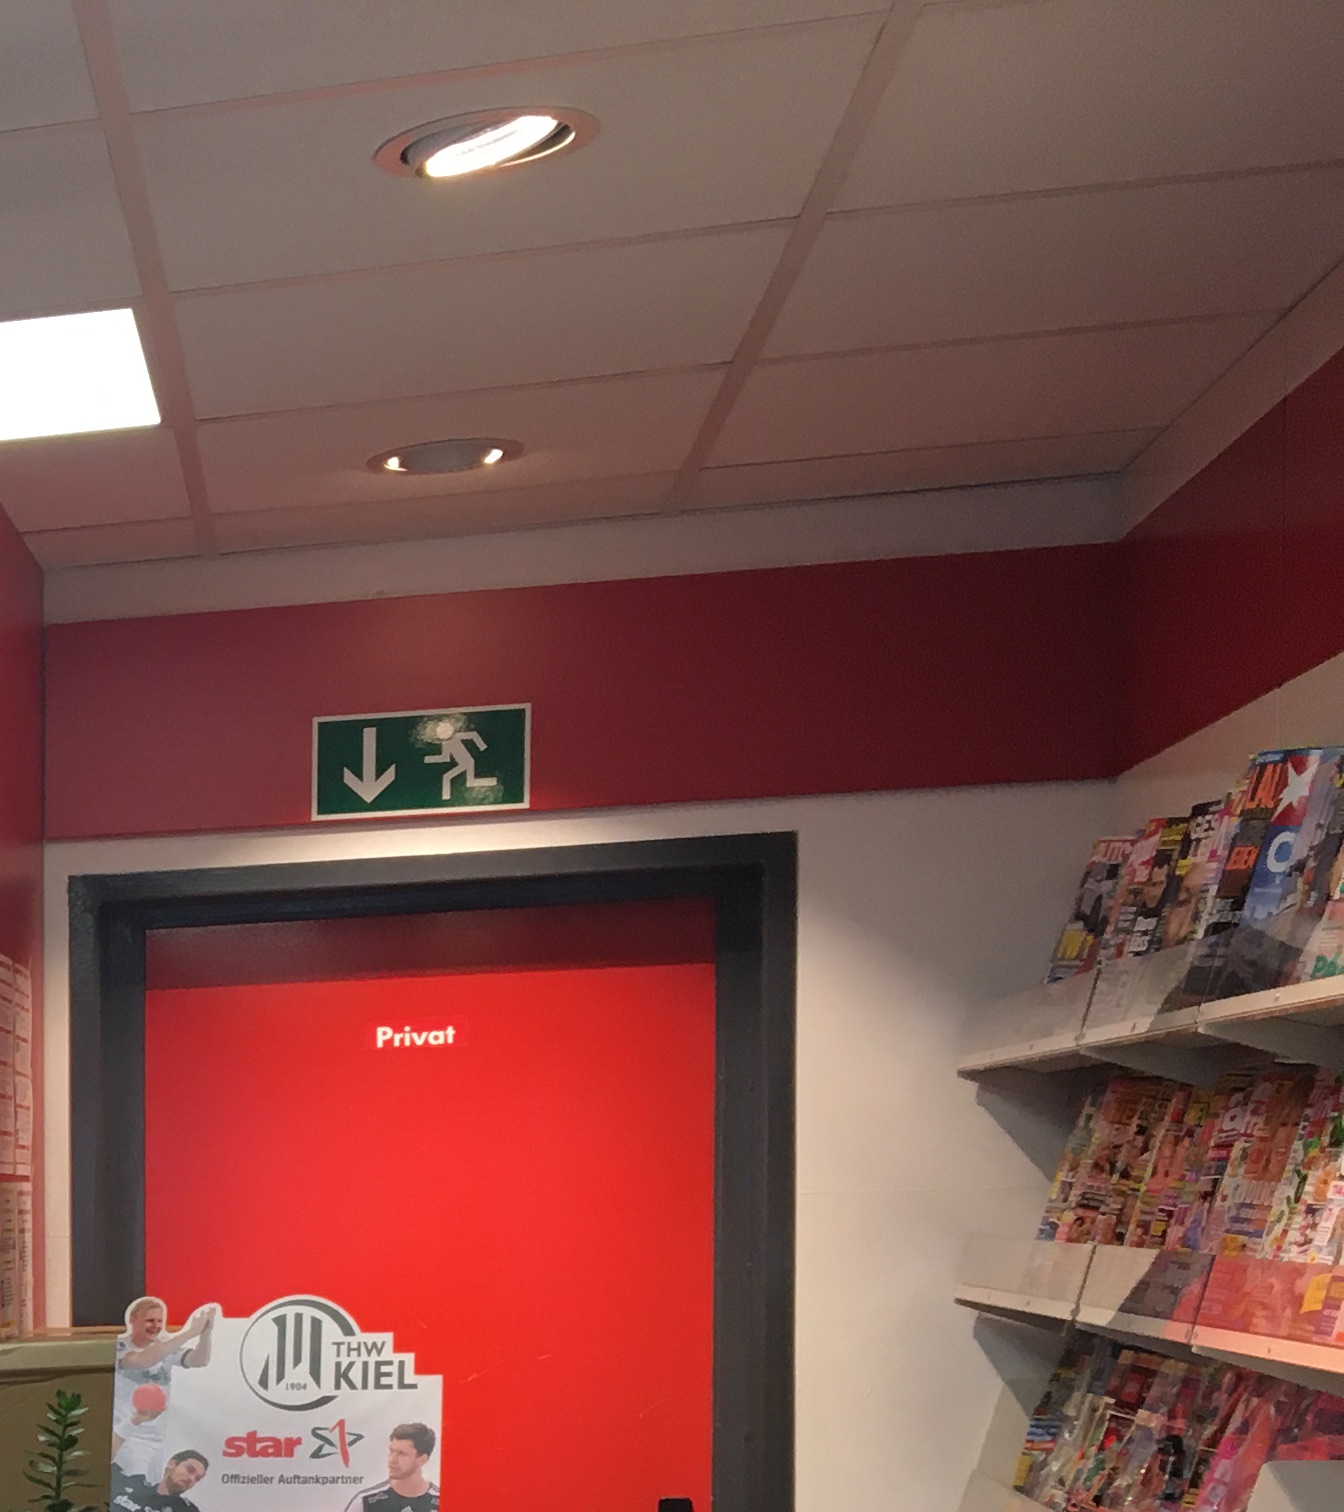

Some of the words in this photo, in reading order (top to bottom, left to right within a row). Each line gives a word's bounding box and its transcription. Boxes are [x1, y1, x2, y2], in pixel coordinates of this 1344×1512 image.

[376, 1025, 456, 1049] Privat
[331, 1341, 386, 1359] THW
[333, 1360, 418, 1391] KIEL
[222, 1430, 302, 1459] star
[221, 1473, 274, 1486] Offizieller
[277, 1473, 364, 1487] Auftankpartner
